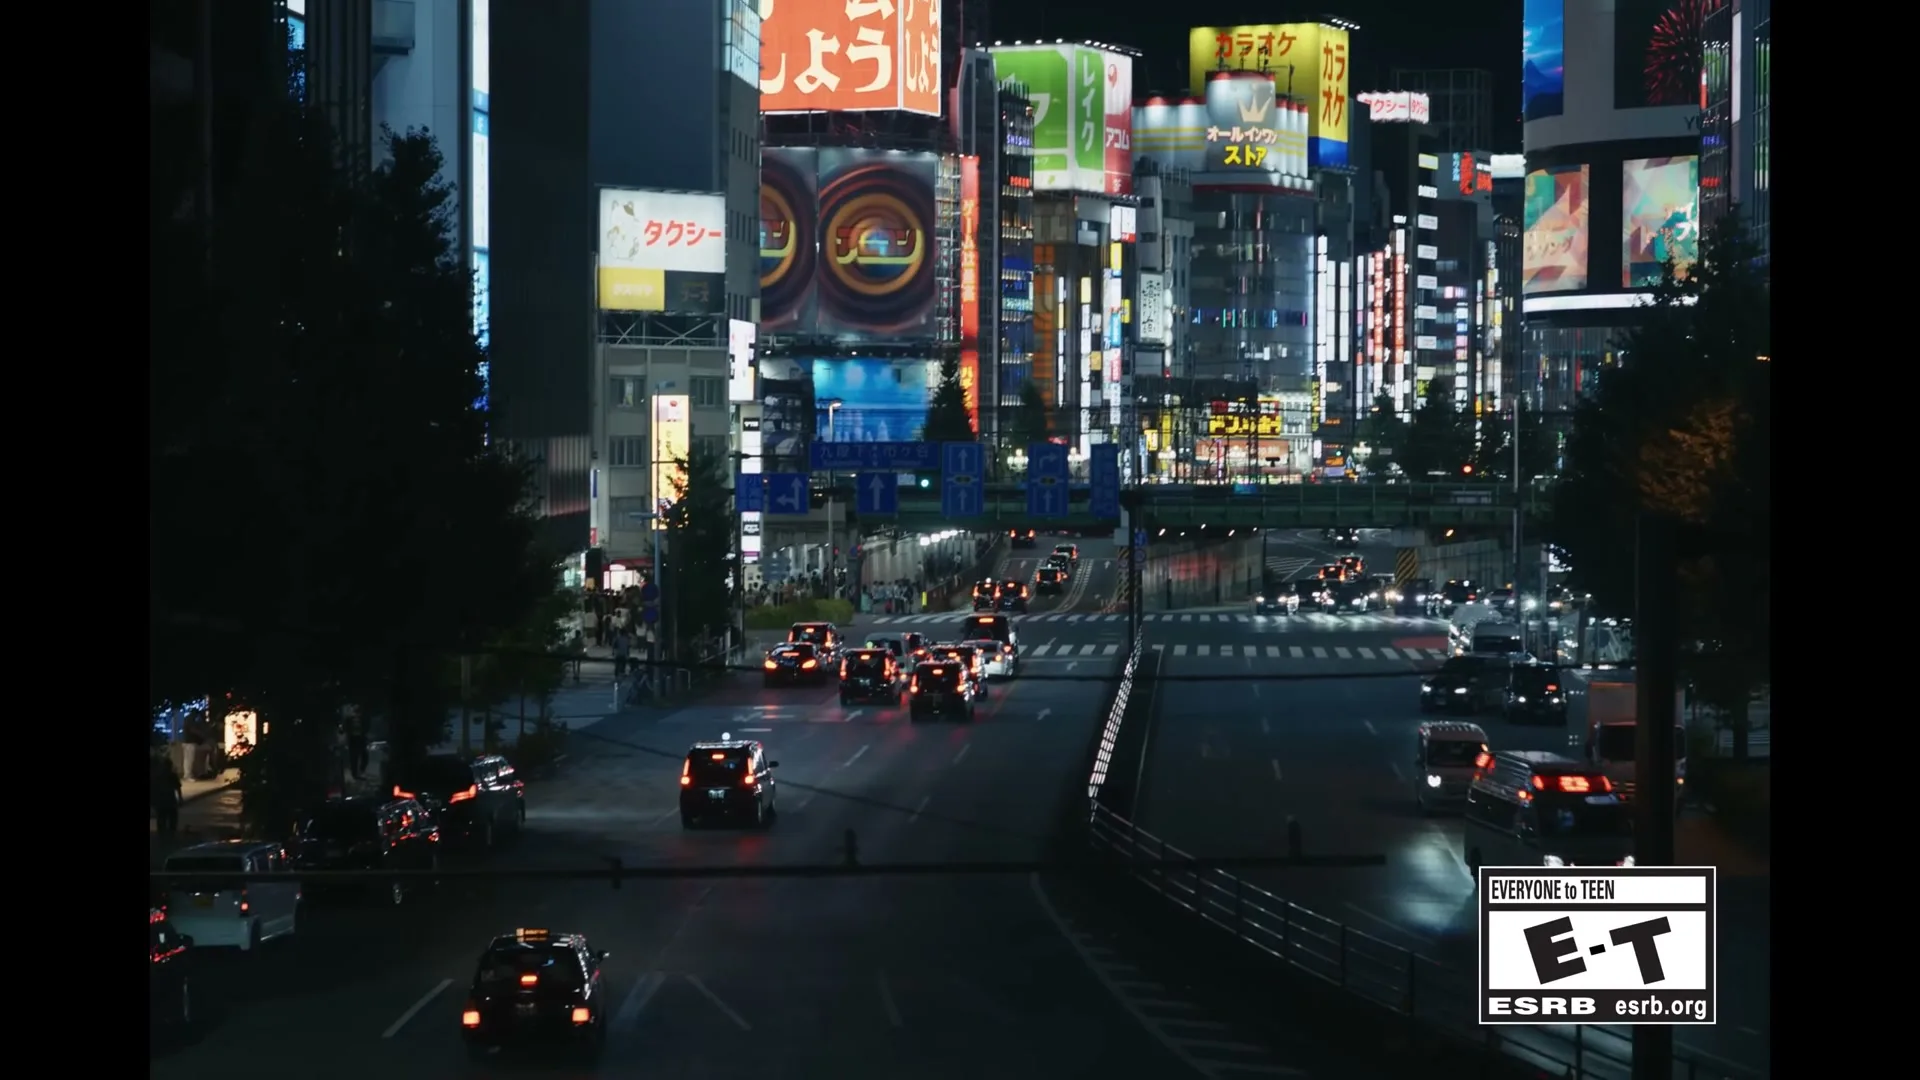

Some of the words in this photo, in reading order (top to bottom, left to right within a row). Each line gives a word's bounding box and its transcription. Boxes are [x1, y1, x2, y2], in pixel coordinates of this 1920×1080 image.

[1215, 31, 1297, 58] カラオケ
[1081, 55, 1095, 152] レイク
[1105, 127, 1130, 150] アコム
[1223, 145, 1267, 166] ストア
[644, 220, 722, 247] タクシー
